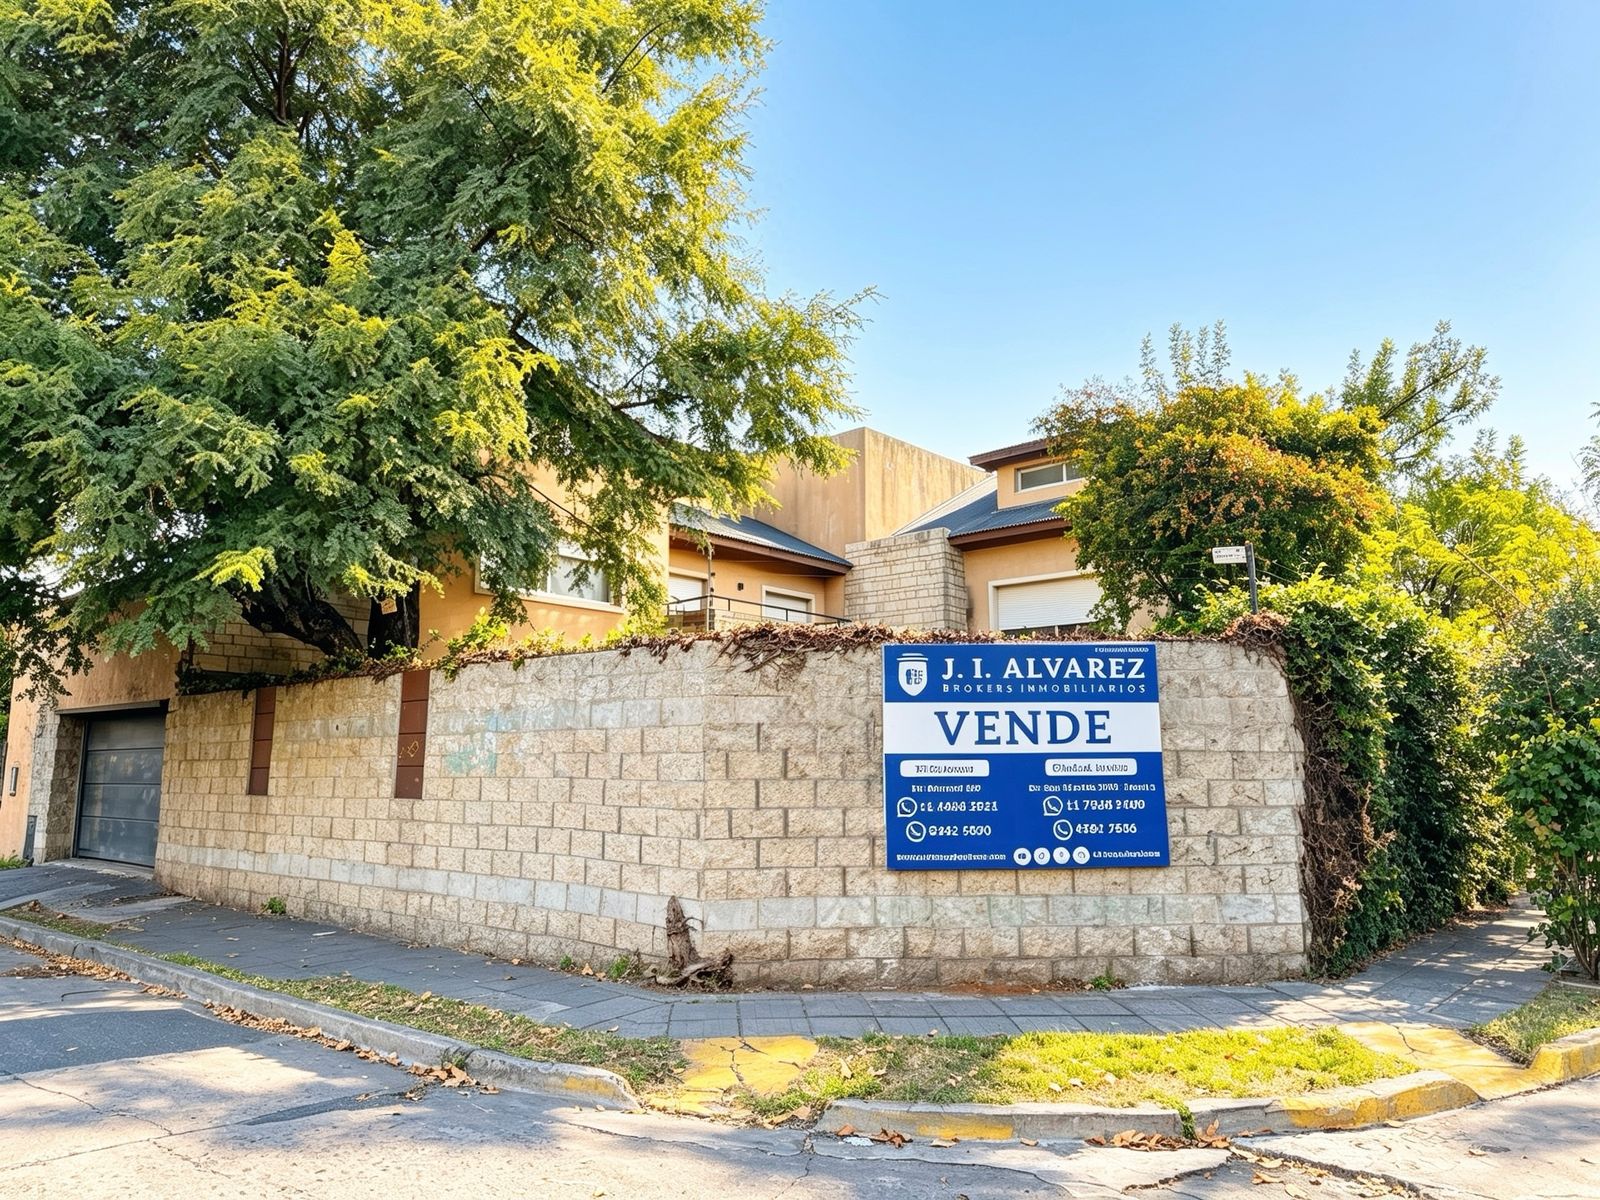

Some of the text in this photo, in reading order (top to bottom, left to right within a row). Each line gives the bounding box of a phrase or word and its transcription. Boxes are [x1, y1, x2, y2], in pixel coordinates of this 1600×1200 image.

[942, 657, 963, 680] J.
[973, 657, 991, 679] I.
[1003, 657, 1146, 680] ALVAREZ
[943, 683, 1146, 694] BROKERS INMOBILIARIOS
[933, 710, 1112, 746] VENDE
